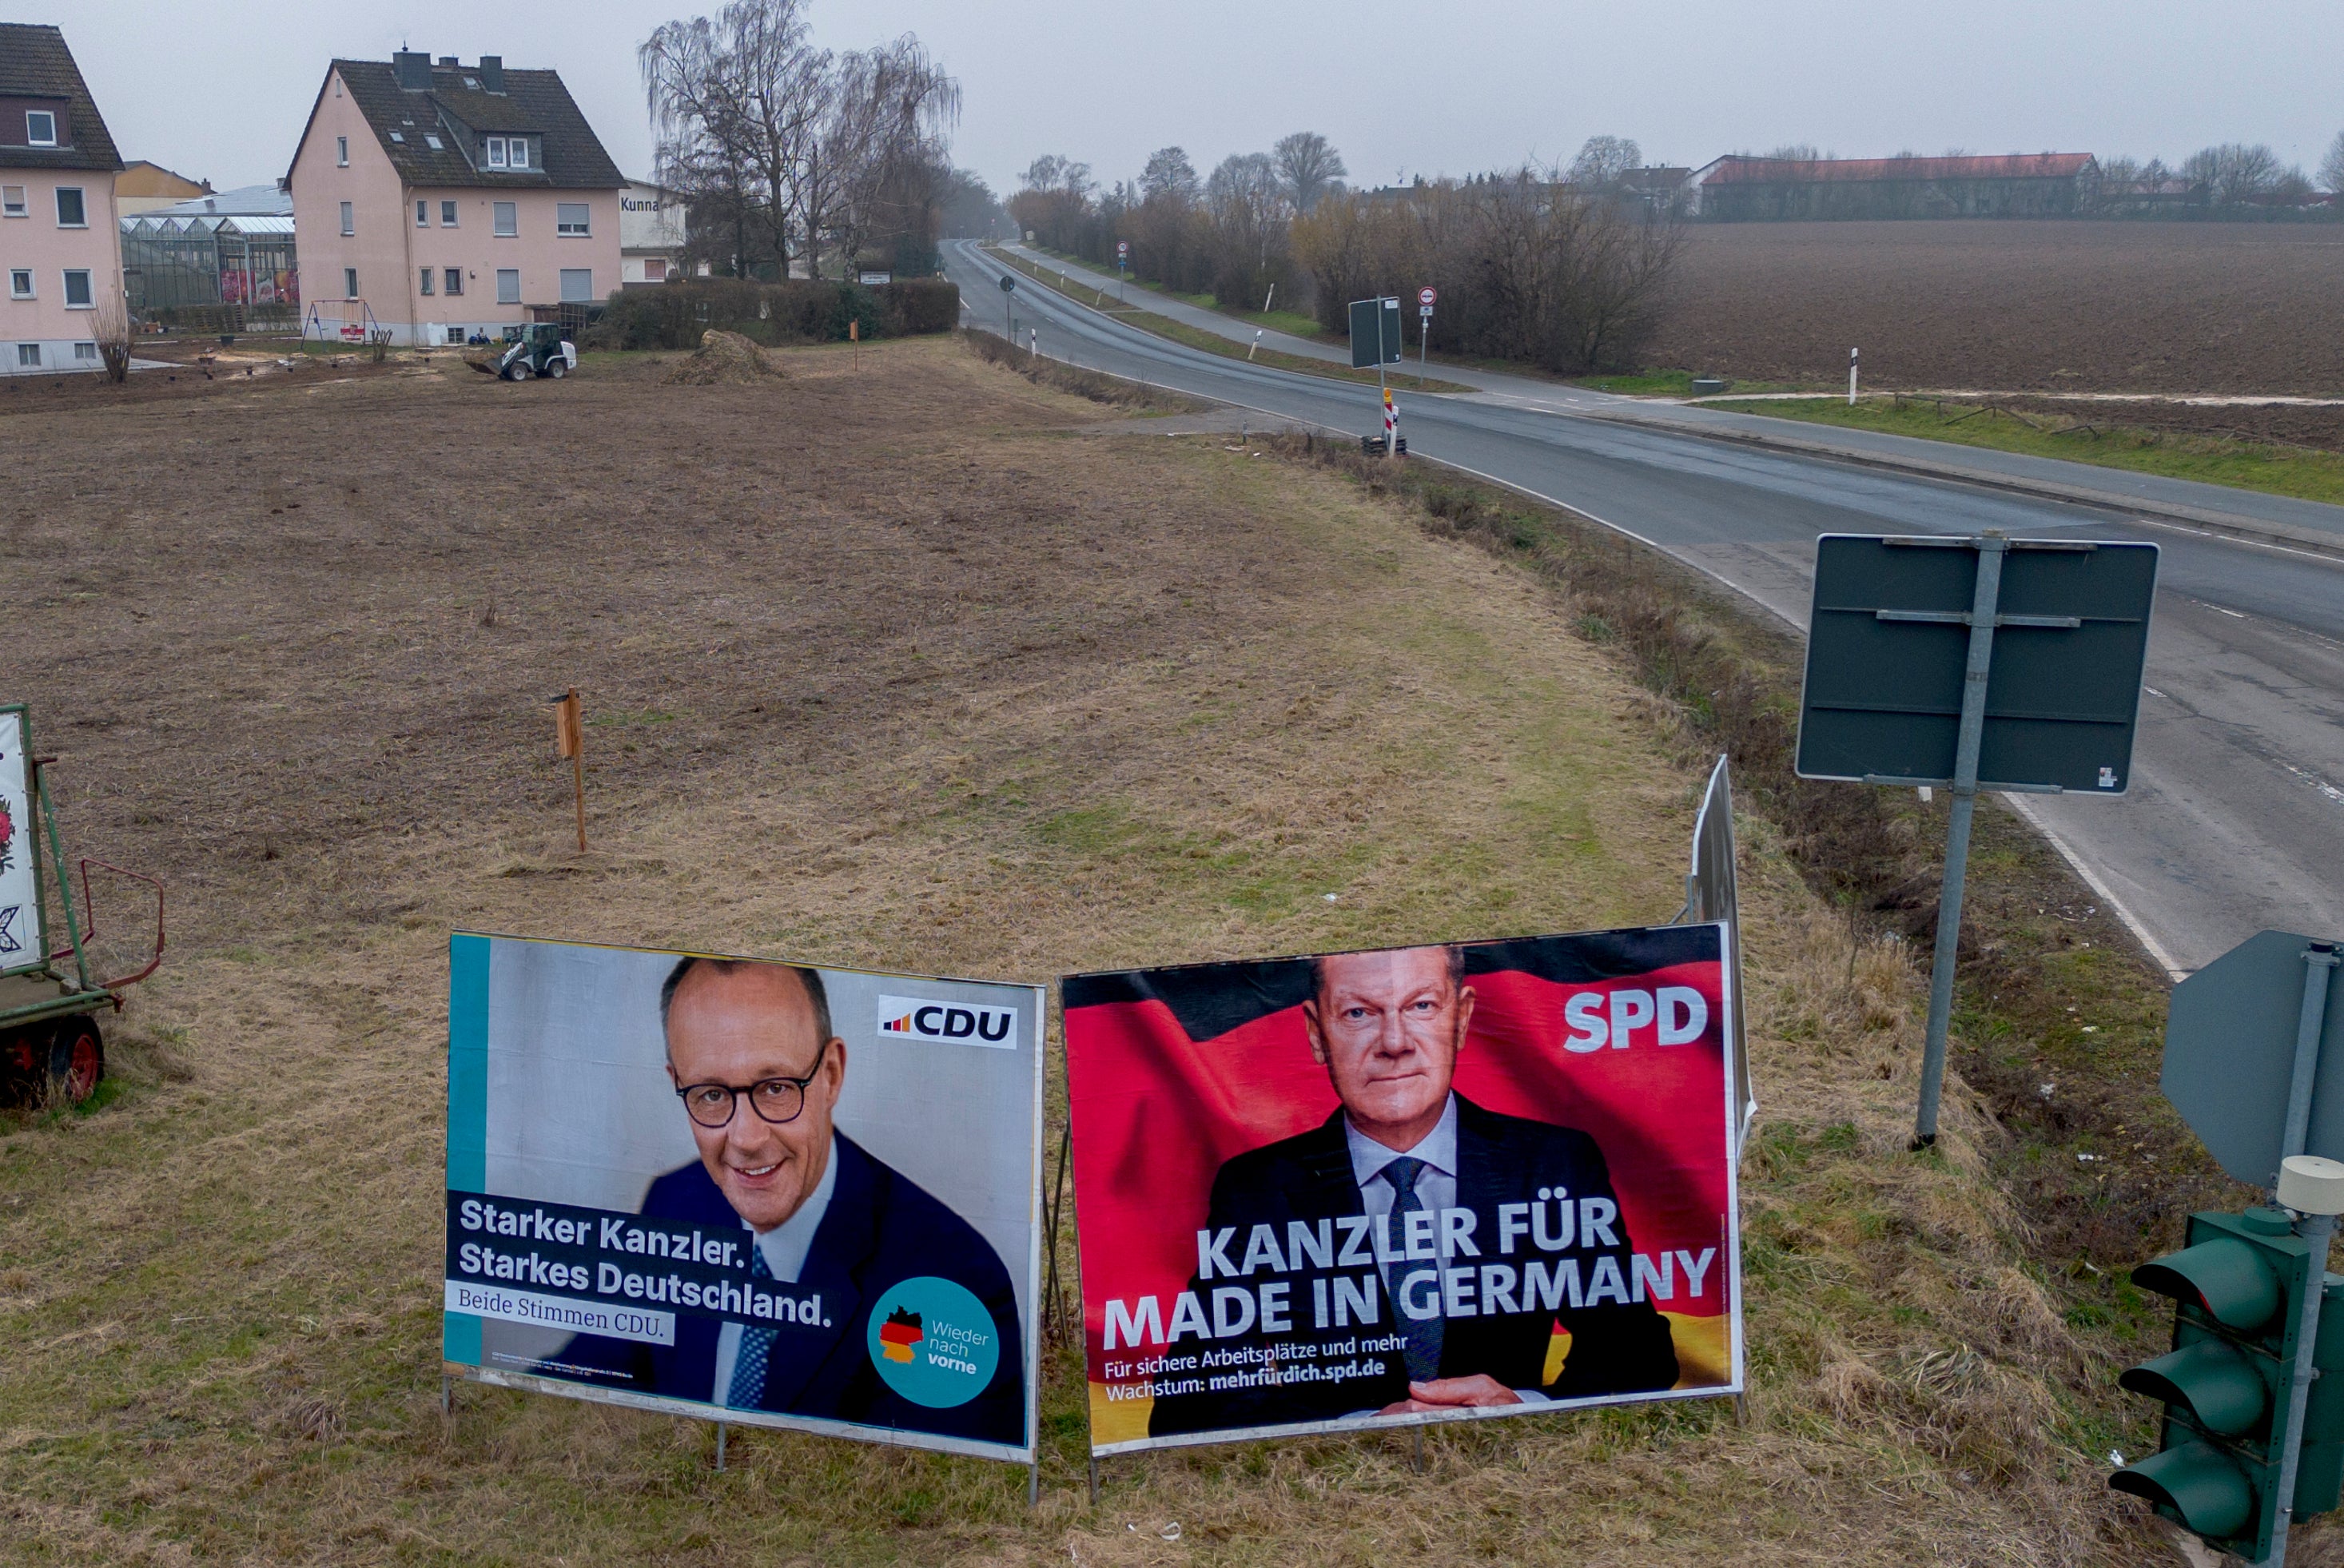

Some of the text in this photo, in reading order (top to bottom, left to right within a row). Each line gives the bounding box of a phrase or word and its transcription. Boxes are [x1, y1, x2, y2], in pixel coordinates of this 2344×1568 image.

[913, 1005, 1012, 1041] CDU
[1563, 986, 1709, 1054] SPD
[460, 1200, 746, 1269] Starker Kanzler.
[1197, 1186, 1621, 1280] KANZLER FÜR
[459, 1243, 833, 1328] Starkes Deutschland.
[1103, 1282, 1292, 1351] MADE
[1312, 1275, 1379, 1328] IN
[1399, 1247, 1717, 1321] GERMANY
[458, 1288, 665, 1338] Beide Stimmen CDU.
[932, 1319, 989, 1347] Wieder
[927, 1352, 977, 1375] vorne
[929, 1338, 969, 1358] nach
[1104, 1333, 1409, 1379] Für sichere Arbeitsplätze und mehr
[1105, 1358, 1386, 1402] Wachstum: mehrfürdich.spd.de
